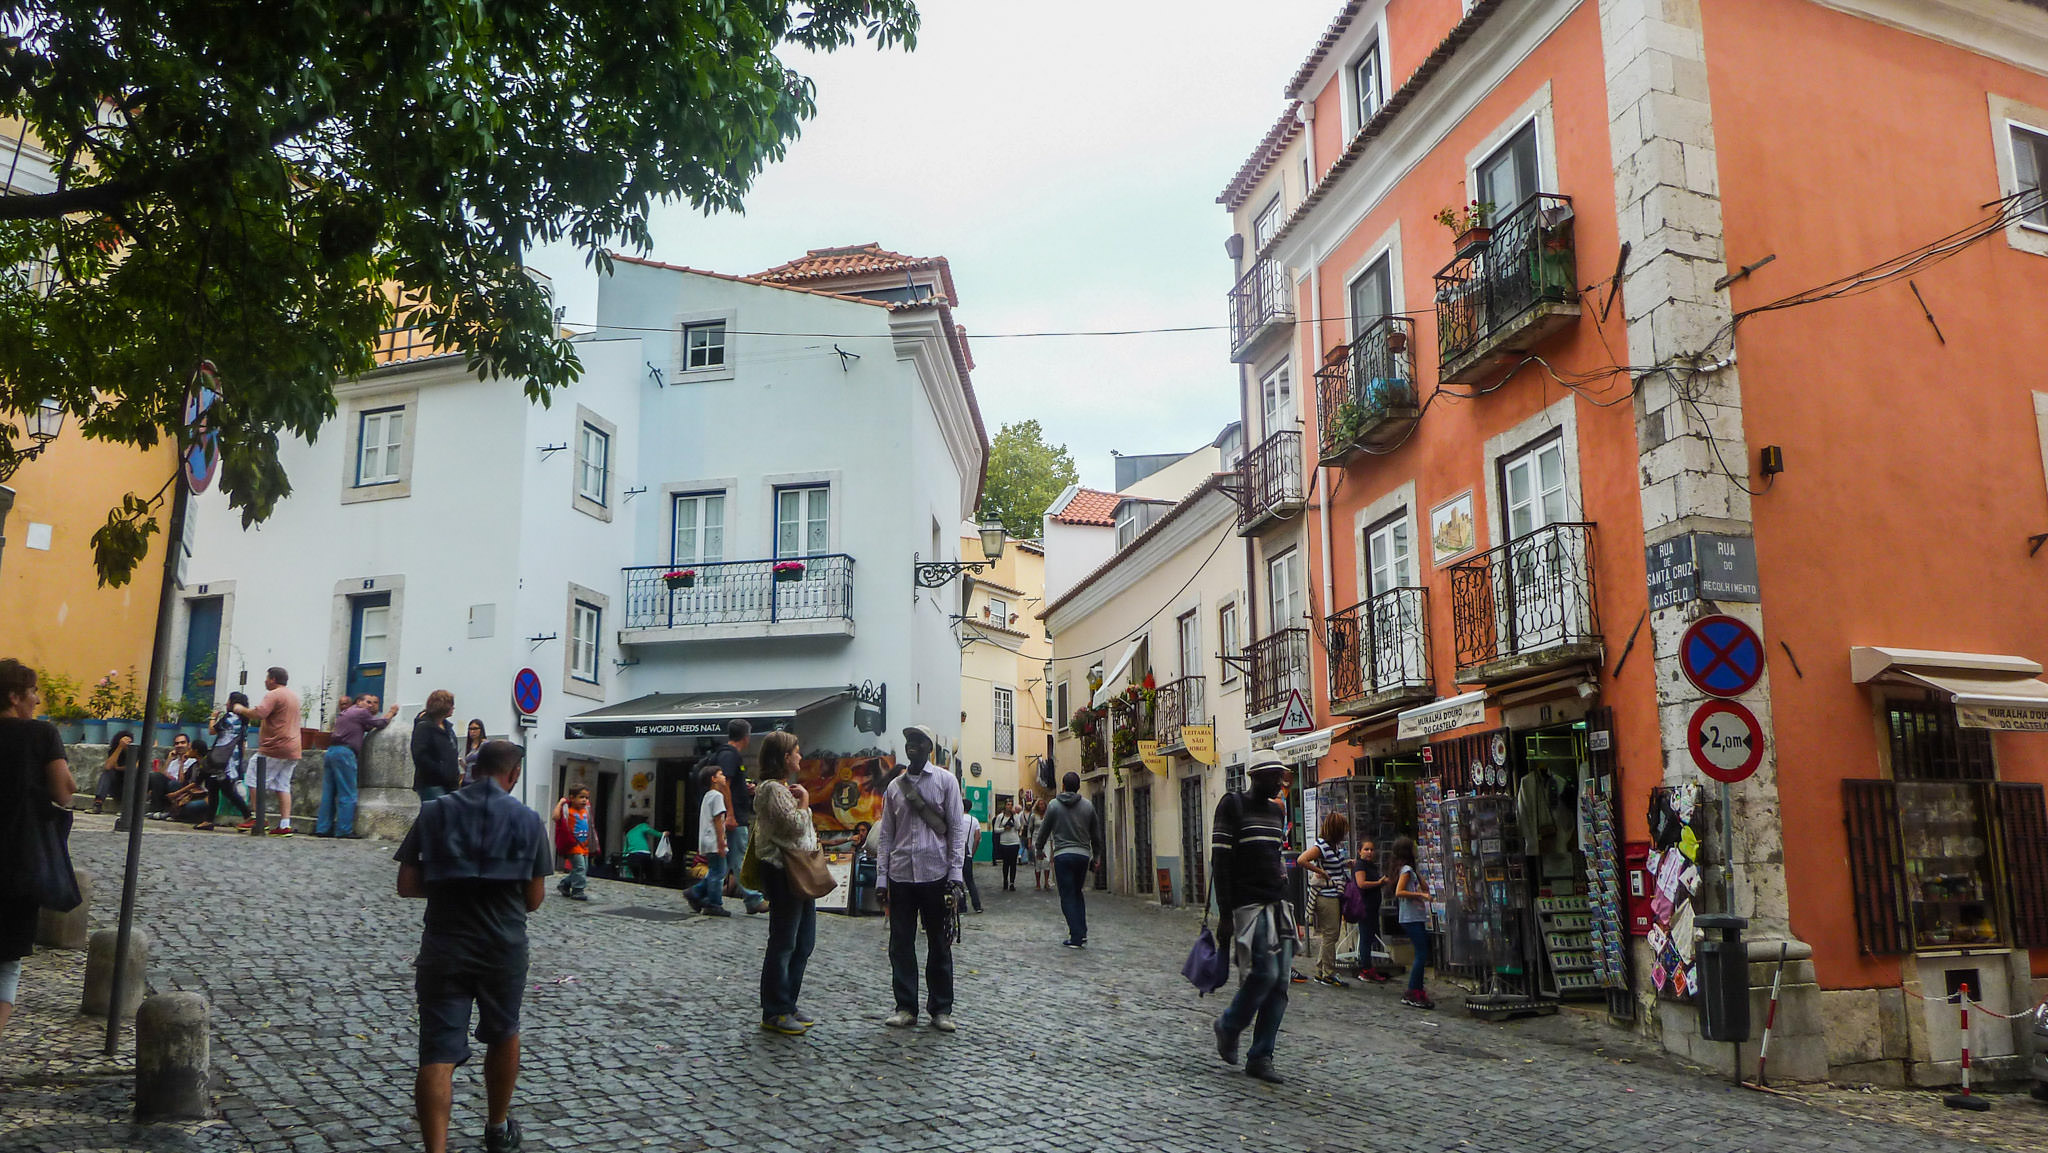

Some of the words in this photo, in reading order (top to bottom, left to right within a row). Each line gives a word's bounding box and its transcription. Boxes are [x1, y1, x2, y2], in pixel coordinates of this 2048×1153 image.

[1660, 542, 1674, 558] RUA
[1717, 542, 1736, 556] RUA
[1663, 558, 1671, 567] DE
[1723, 561, 1733, 571] DO
[1647, 567, 1671, 586] SANTA
[1672, 561, 1693, 579] CRUZ
[1665, 580, 1673, 590] DO
[1703, 580, 1757, 595] RECOLHIMENTO
[1654, 587, 1688, 608] CASTELO
[1418, 713, 1442, 725] MURALHA
[1987, 708, 2028, 719] MURALHA
[635, 726, 648, 734] THE
[648, 725, 675, 733] WORLD
[676, 724, 699, 733] NEEDS
[700, 723, 721, 732] NATA
[1433, 720, 1456, 731] CASTELO
[2000, 720, 2012, 729] DO
